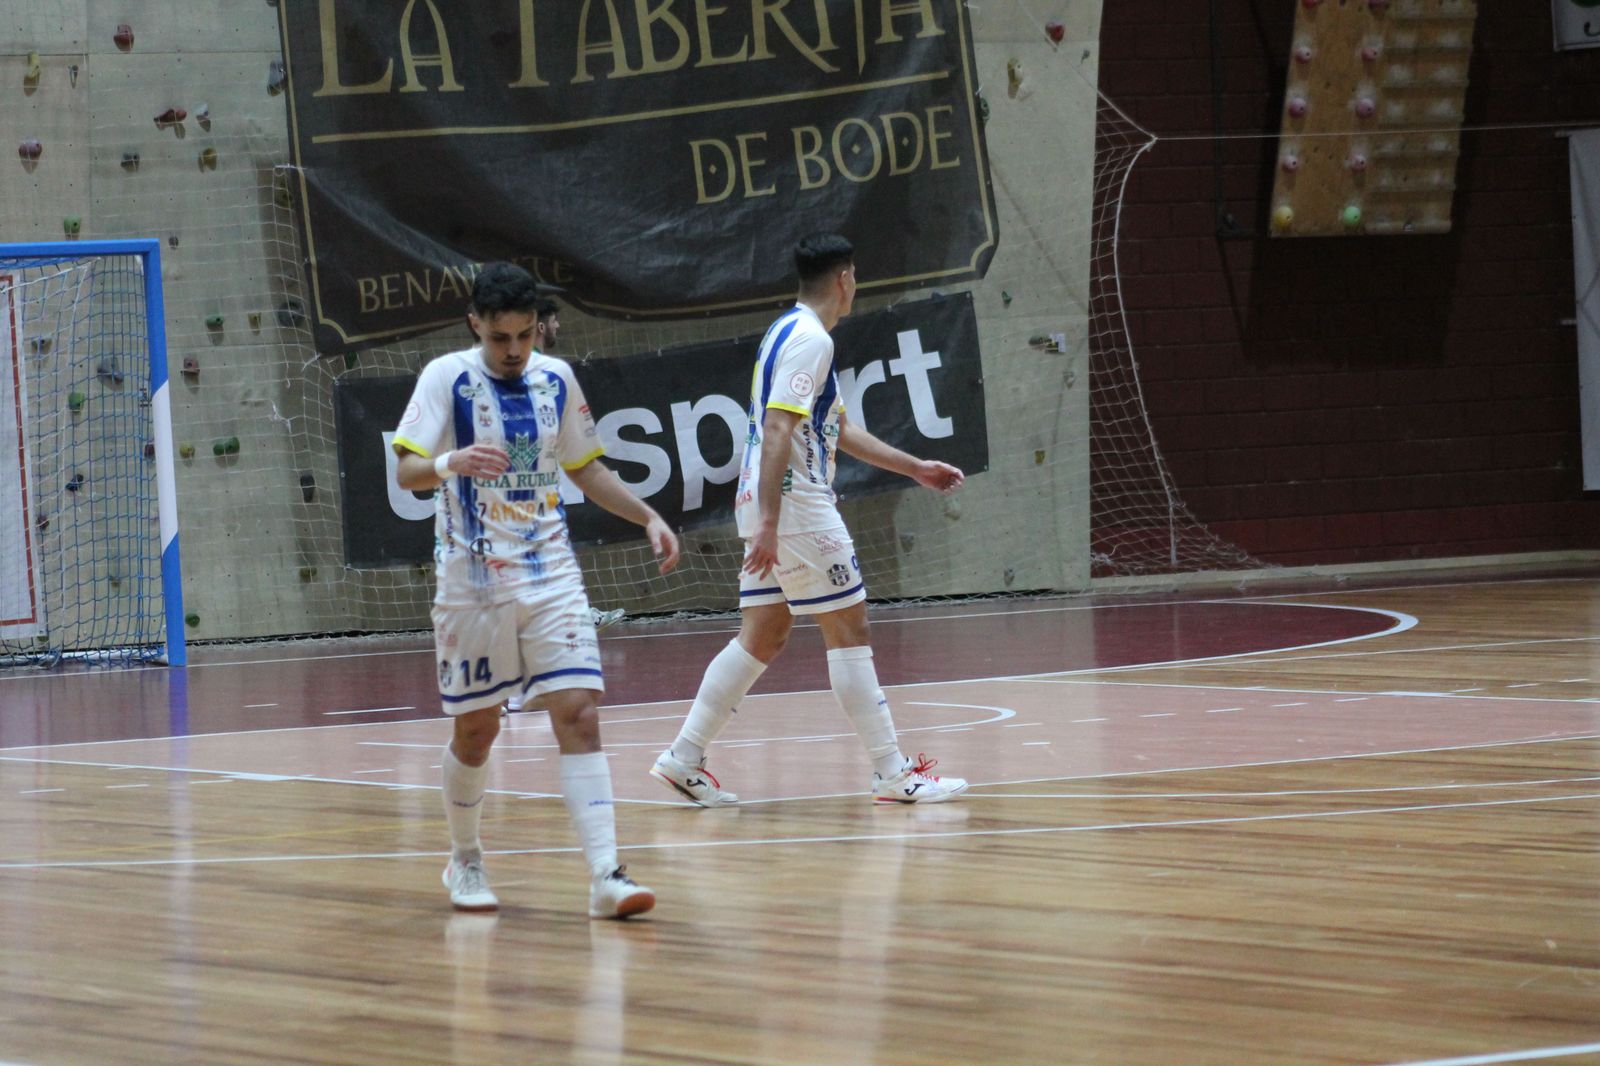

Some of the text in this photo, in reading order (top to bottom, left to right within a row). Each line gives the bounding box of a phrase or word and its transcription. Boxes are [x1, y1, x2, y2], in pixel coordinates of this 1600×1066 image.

[313, 0, 464, 97] LA
[689, 105, 961, 203] DE BODE
[357, 256, 573, 313] BENAVTE
[460, 657, 492, 687] 14
